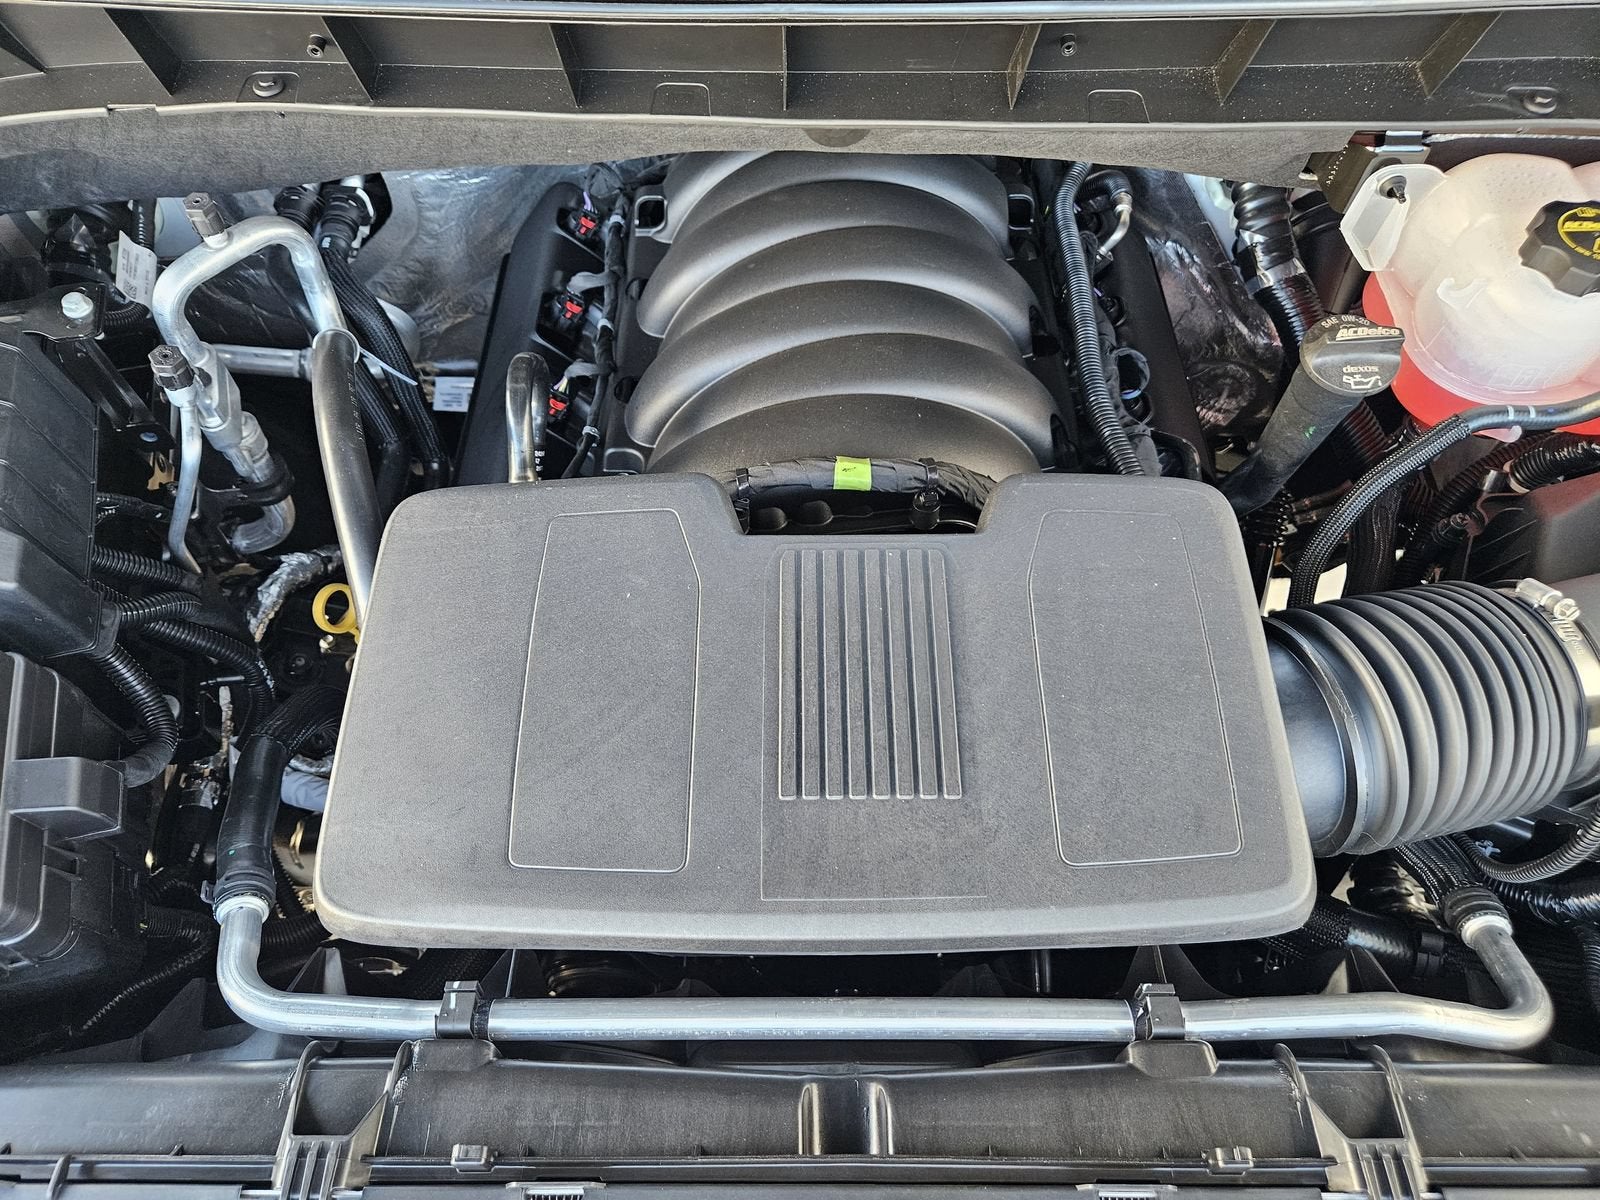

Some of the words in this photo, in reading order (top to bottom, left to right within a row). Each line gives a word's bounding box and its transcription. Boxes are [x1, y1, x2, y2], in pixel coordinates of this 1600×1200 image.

[1321, 316, 1339, 328] SAE
[1336, 326, 1400, 338] ACDelco
[1343, 365, 1379, 373] dexos
